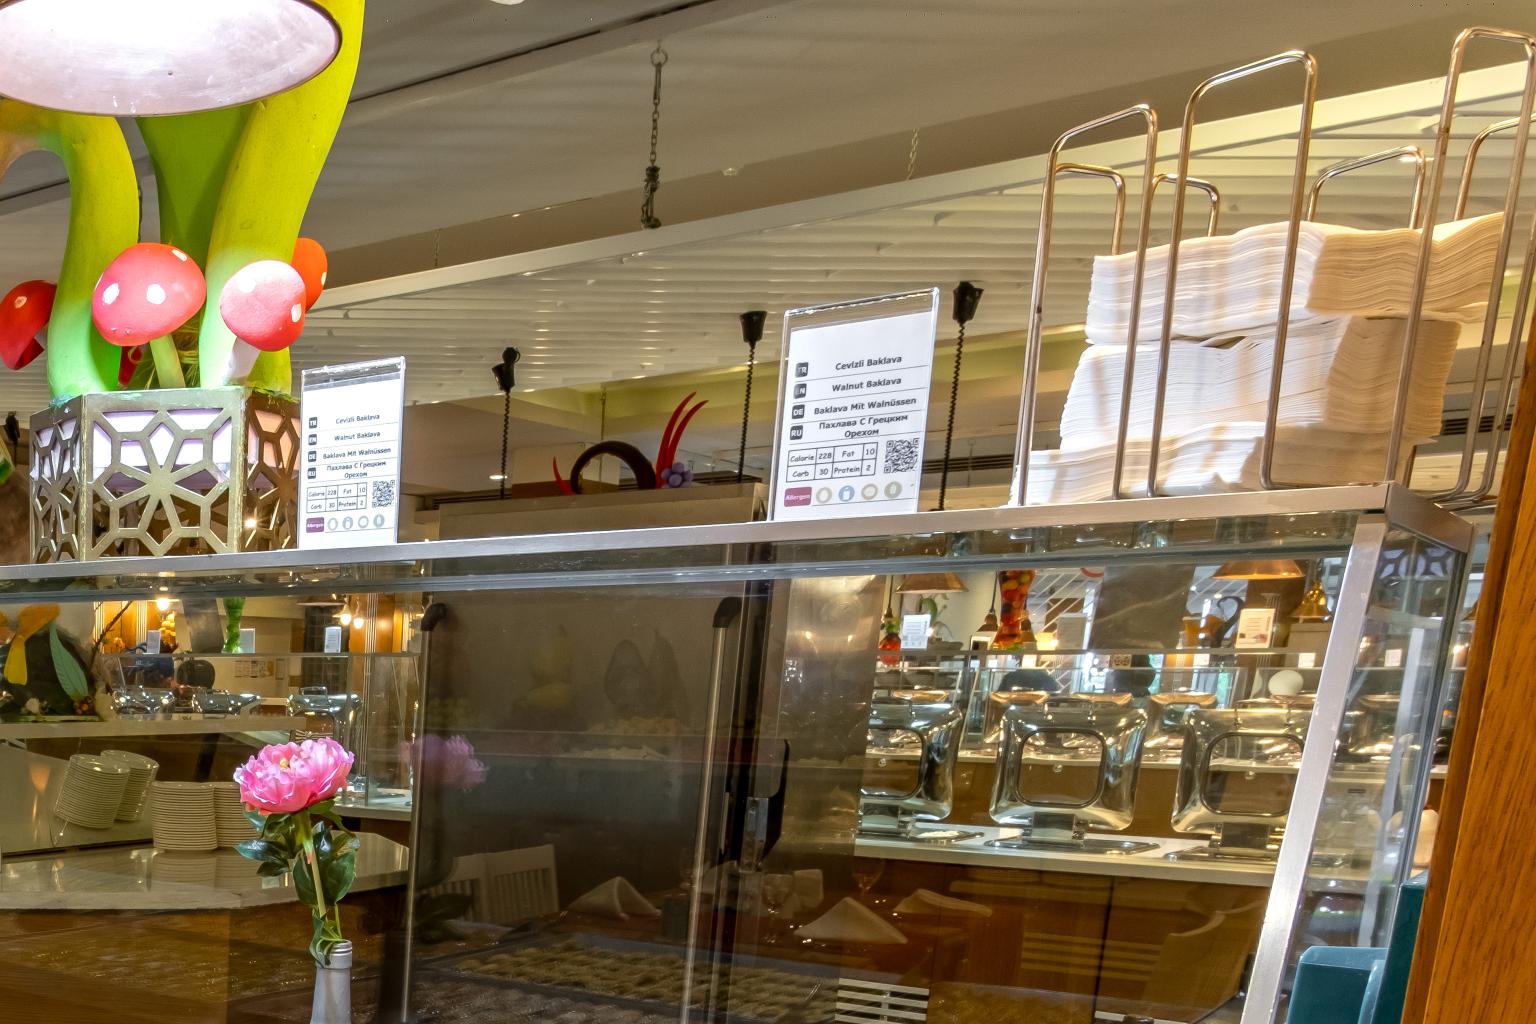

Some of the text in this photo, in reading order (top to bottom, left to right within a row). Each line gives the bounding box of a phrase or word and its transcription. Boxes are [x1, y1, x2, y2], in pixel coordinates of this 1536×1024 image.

[835, 356, 902, 371] Cevizli Baklava
[832, 378, 902, 392] Walnut Baklava
[814, 398, 917, 415] Baklava Mit Walnüssen
[356, 414, 380, 422] Baklava
[819, 420, 857, 430] Пахлава
[868, 415, 908, 426] Грецким
[357, 431, 381, 439] Baklava
[791, 429, 802, 437] RU
[844, 429, 879, 439] Орехом
[790, 454, 815, 463] Calorie
[818, 452, 832, 460] 228
[841, 450, 855, 458] Fat
[792, 470, 810, 478] Carb
[834, 466, 860, 474] Protein
[866, 464, 871, 472] 2
